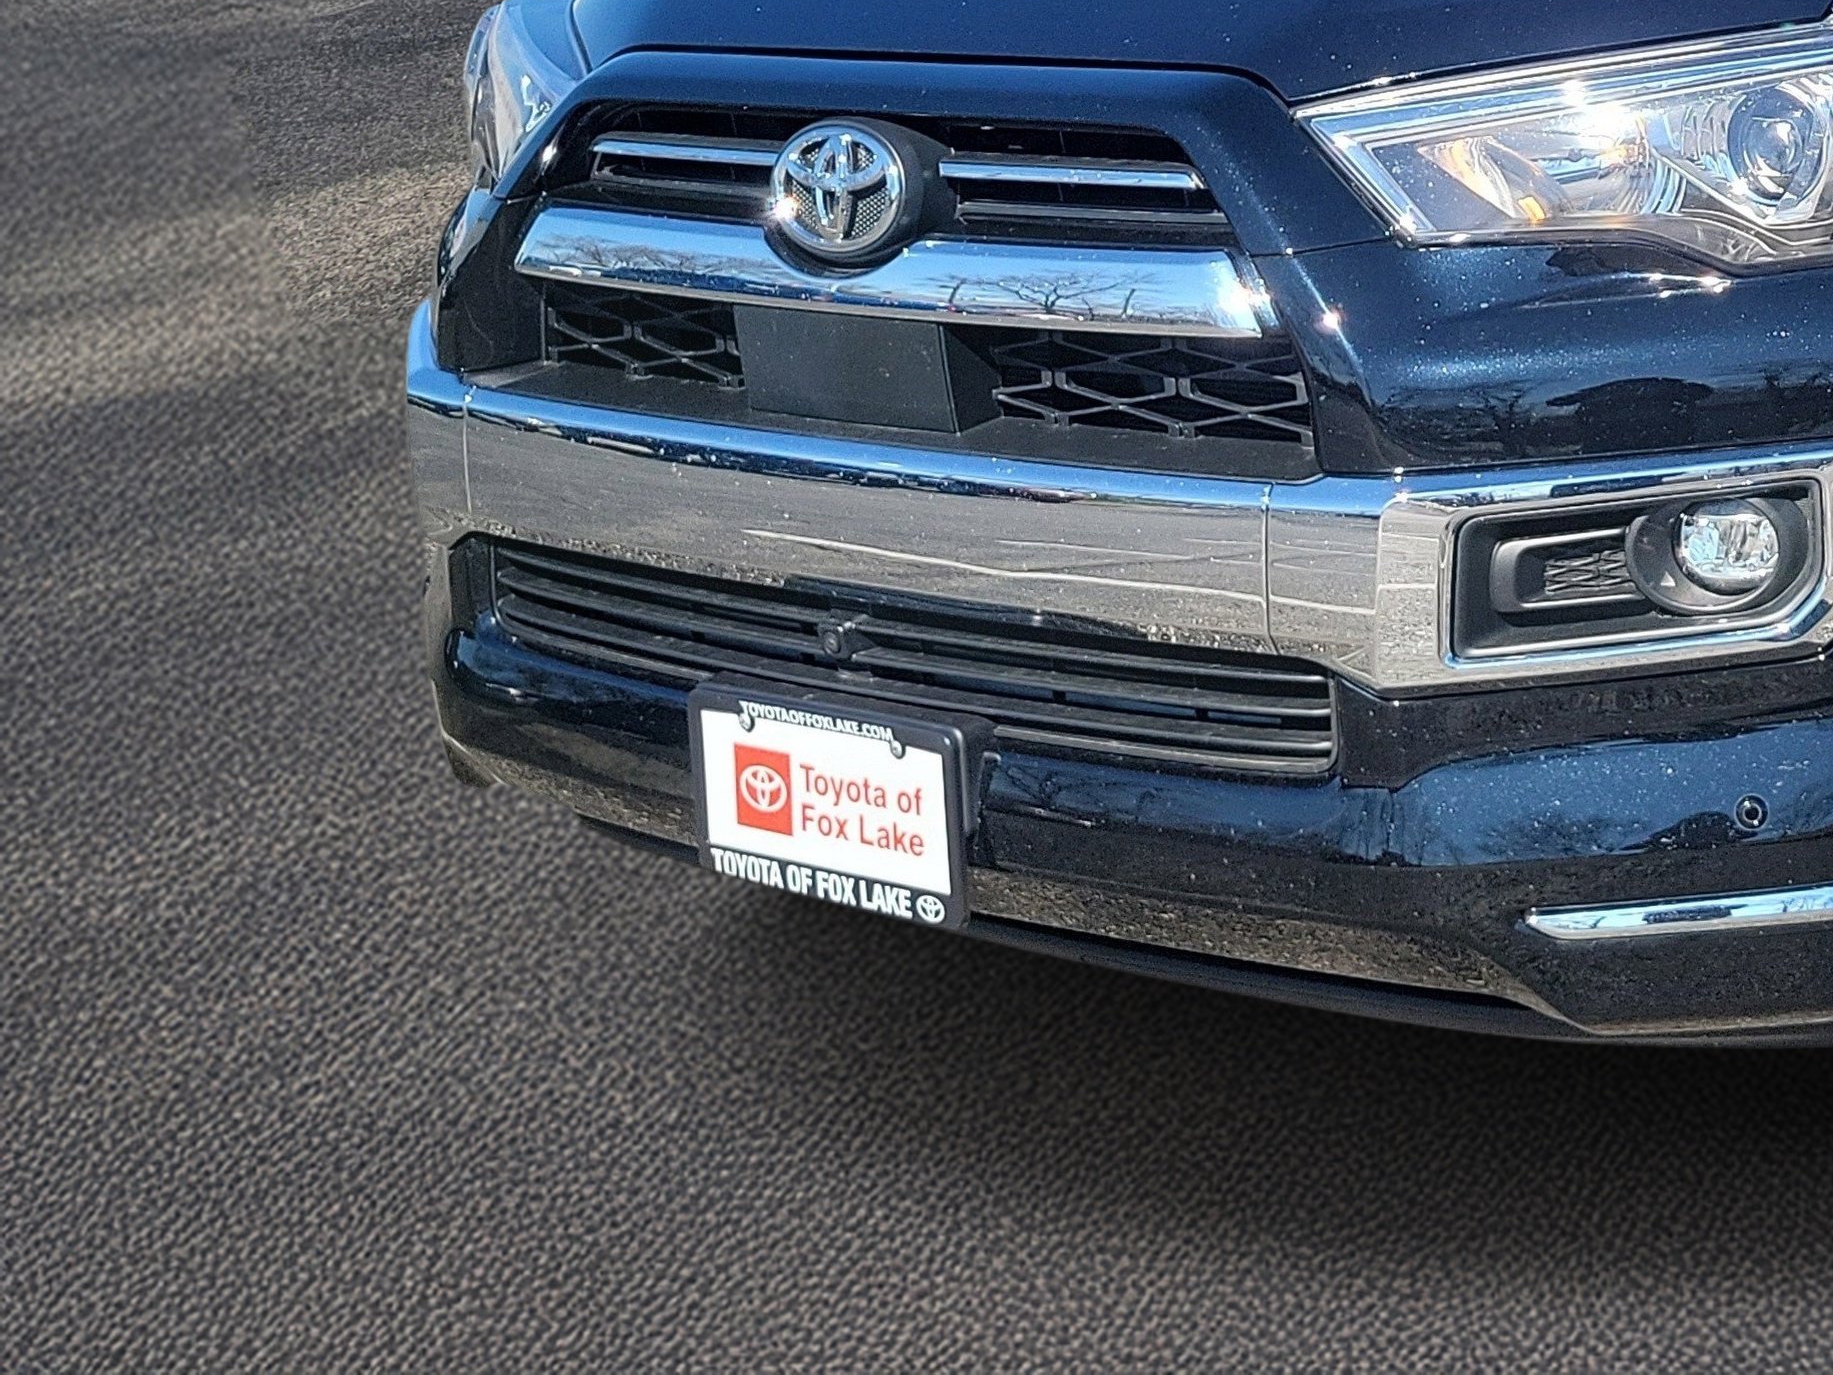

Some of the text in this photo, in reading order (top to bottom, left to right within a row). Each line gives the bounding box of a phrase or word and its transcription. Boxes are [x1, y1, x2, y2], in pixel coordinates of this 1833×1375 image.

[738, 700, 894, 743] TOYOTAOFFOXLAKE.COM
[799, 763, 923, 816] Toyota of
[801, 804, 925, 857] Fox Lake
[710, 847, 913, 919] TOYOTA OF FOX LAKE
